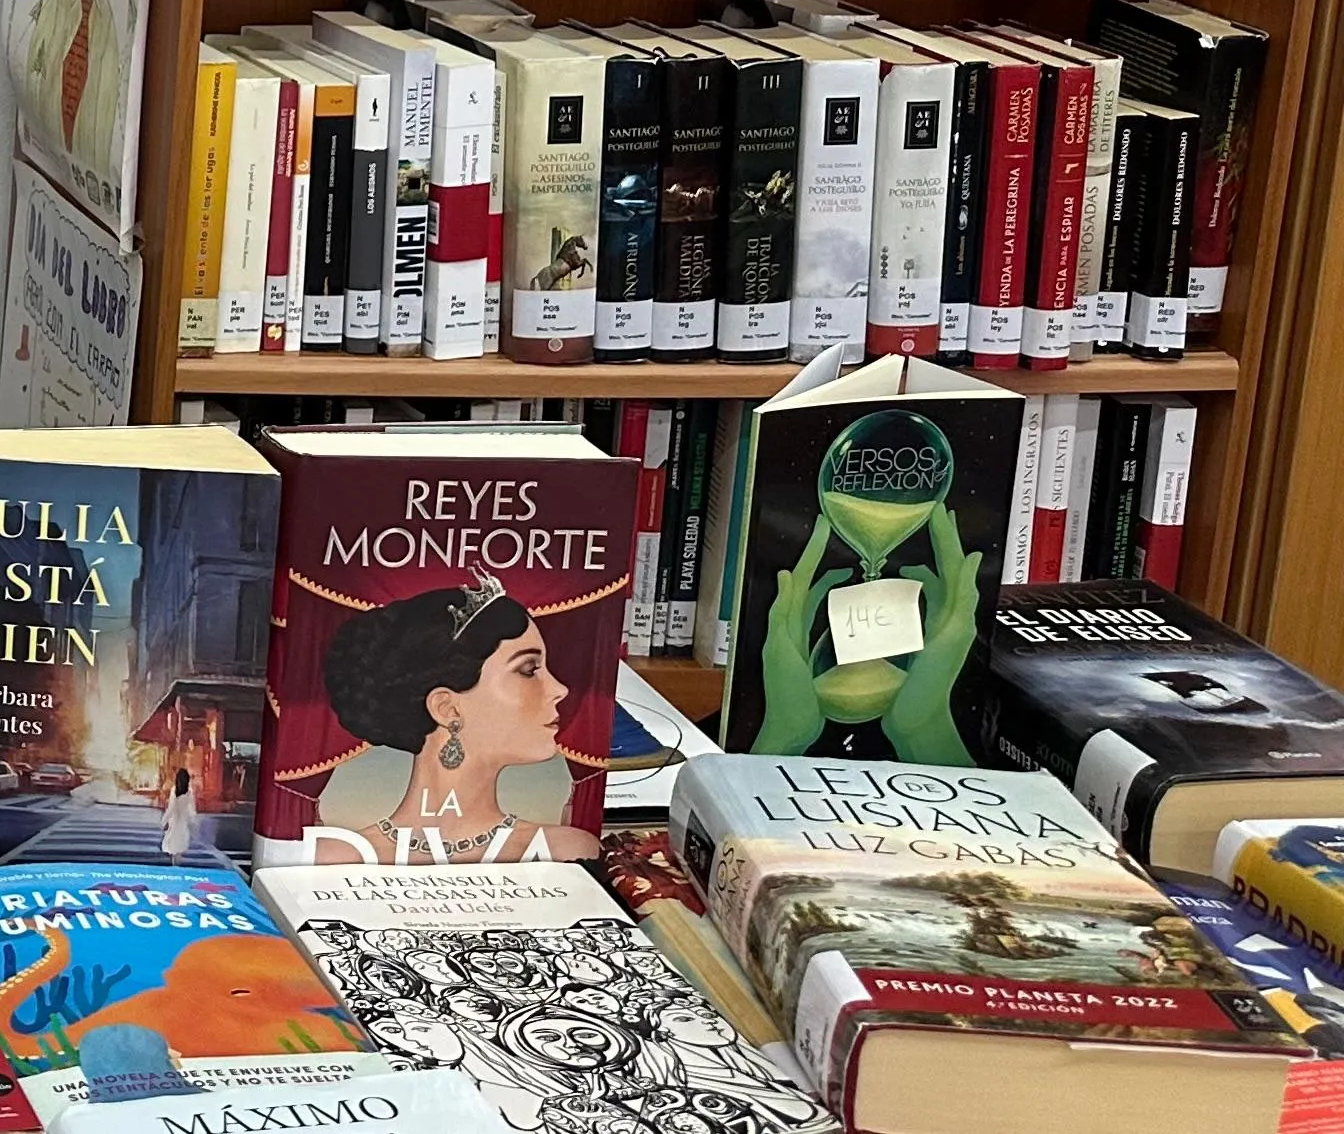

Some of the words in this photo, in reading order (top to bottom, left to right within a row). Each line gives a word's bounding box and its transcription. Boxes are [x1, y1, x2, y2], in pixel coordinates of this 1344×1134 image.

[404, 85, 418, 147] MANUEL
[418, 71, 434, 147] PIMENTEL
[1006, 90, 1022, 144] CARMEN
[1017, 86, 1034, 144] POSADAS
[739, 126, 795, 138] SANTIAGO
[530, 162, 595, 173] POSTEGUILLO
[537, 152, 590, 163] SANTIAGO
[531, 182, 593, 194] EMPERADOR
[1005, 167, 1022, 241] PEREGRINA
[830, 447, 936, 474] VERSOS
[405, 481, 538, 522] REYES
[322, 527, 607, 572] MONFORTE
[995, 611, 1028, 627] EL
[1033, 606, 1167, 625] DIARIO
[1012, 623, 1059, 644] DE
[1065, 623, 1193, 643] ELISEO
[773, 765, 1007, 806] LEJOS
[754, 794, 1085, 841] LUISIANA
[802, 830, 899, 858] LUZ
[907, 836, 1077, 871] GABÁS
[312, 890, 348, 901] DE
[353, 890, 397, 900] LAS
[404, 889, 478, 900] CASAS
[479, 886, 568, 898] VACÍAS
[344, 877, 376, 887] LA
[381, 875, 516, 887] PENÍNSULA
[388, 903, 452, 915] David
[457, 903, 514, 913] Uclés
[874, 976, 976, 997] PREMIO
[984, 985, 1102, 1006] PLANETA
[1109, 992, 1178, 1010] 2022
